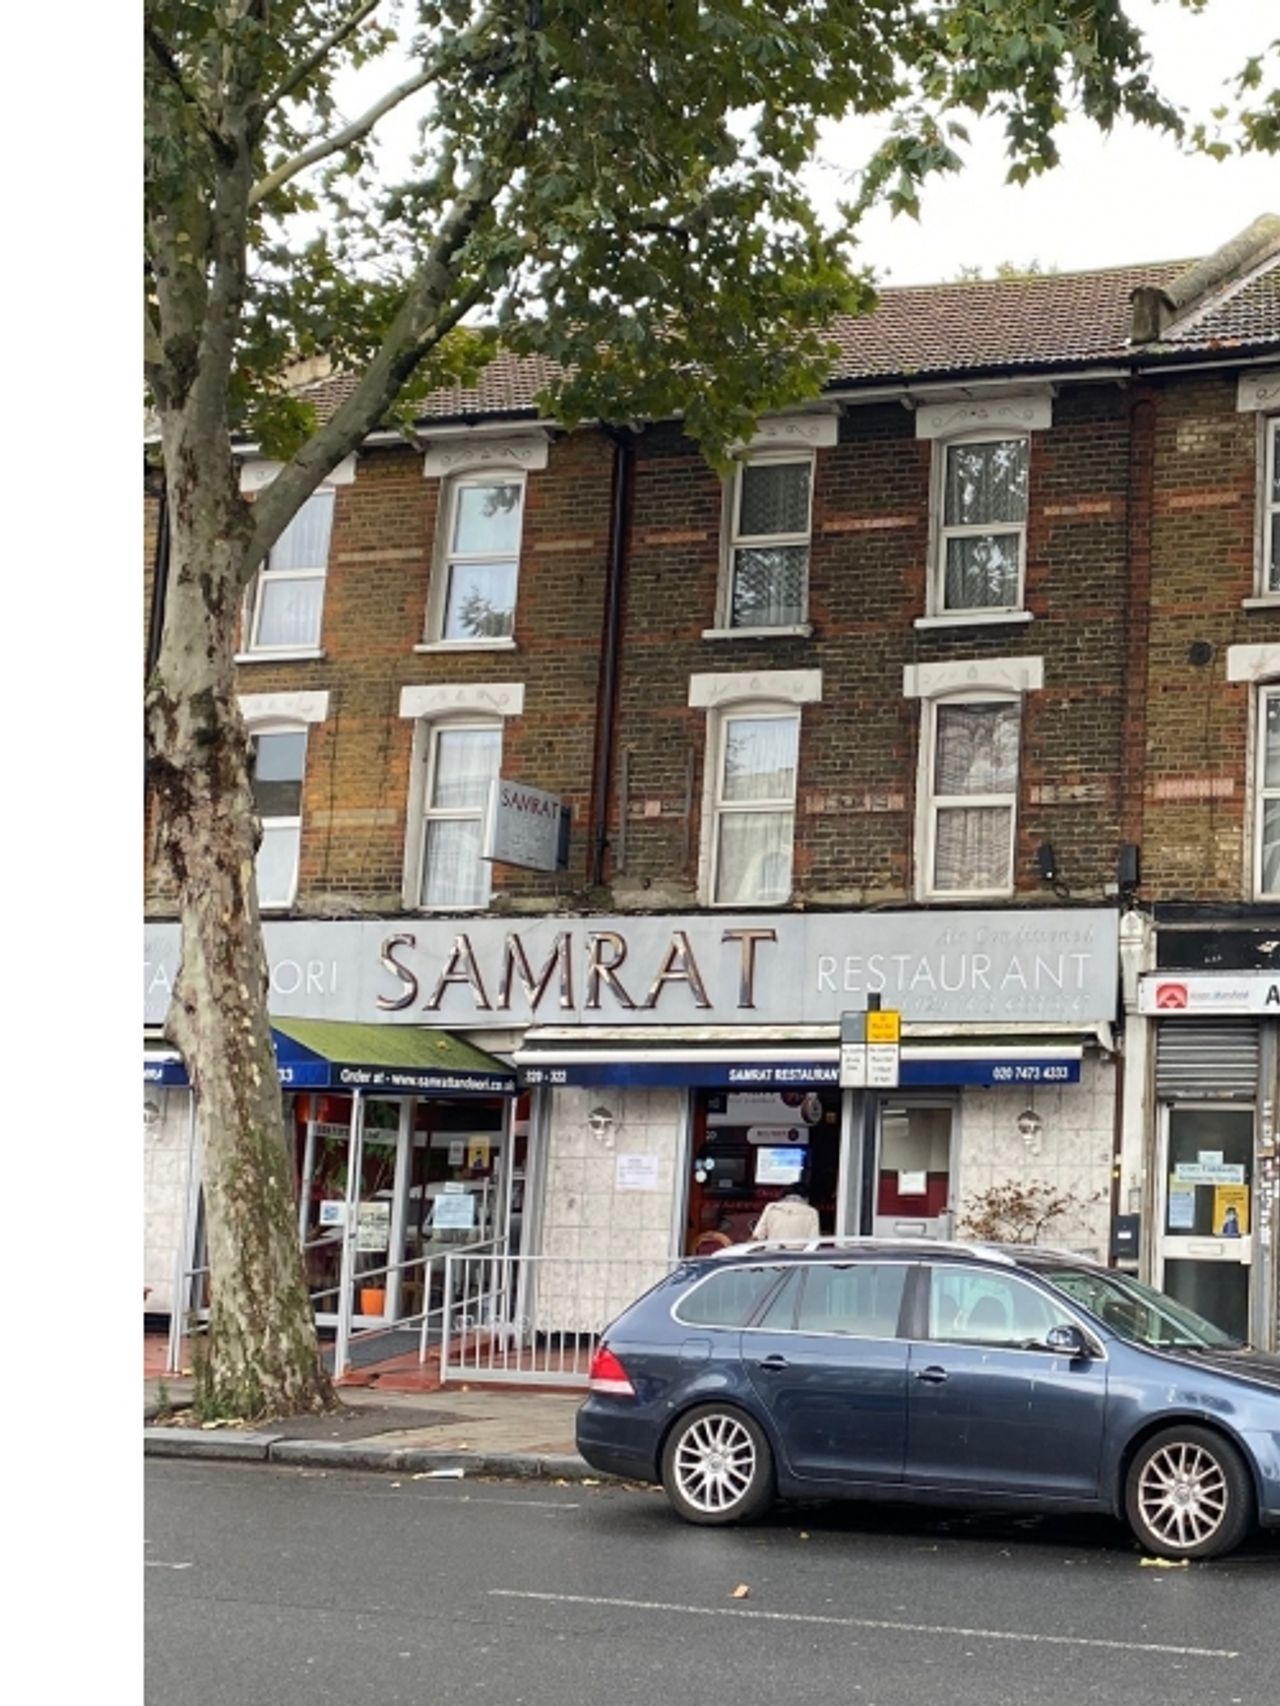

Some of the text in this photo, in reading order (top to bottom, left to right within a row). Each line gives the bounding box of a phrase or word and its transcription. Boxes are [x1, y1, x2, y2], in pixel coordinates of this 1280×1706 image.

[501, 787, 559, 820] SAMRAT
[377, 928, 778, 1012] SAMRAT
[817, 953, 1092, 992] RESTAURANT
[340, 1068, 372, 1085] Order
[728, 1068, 839, 1082] SAMRAT RESTAURAN
